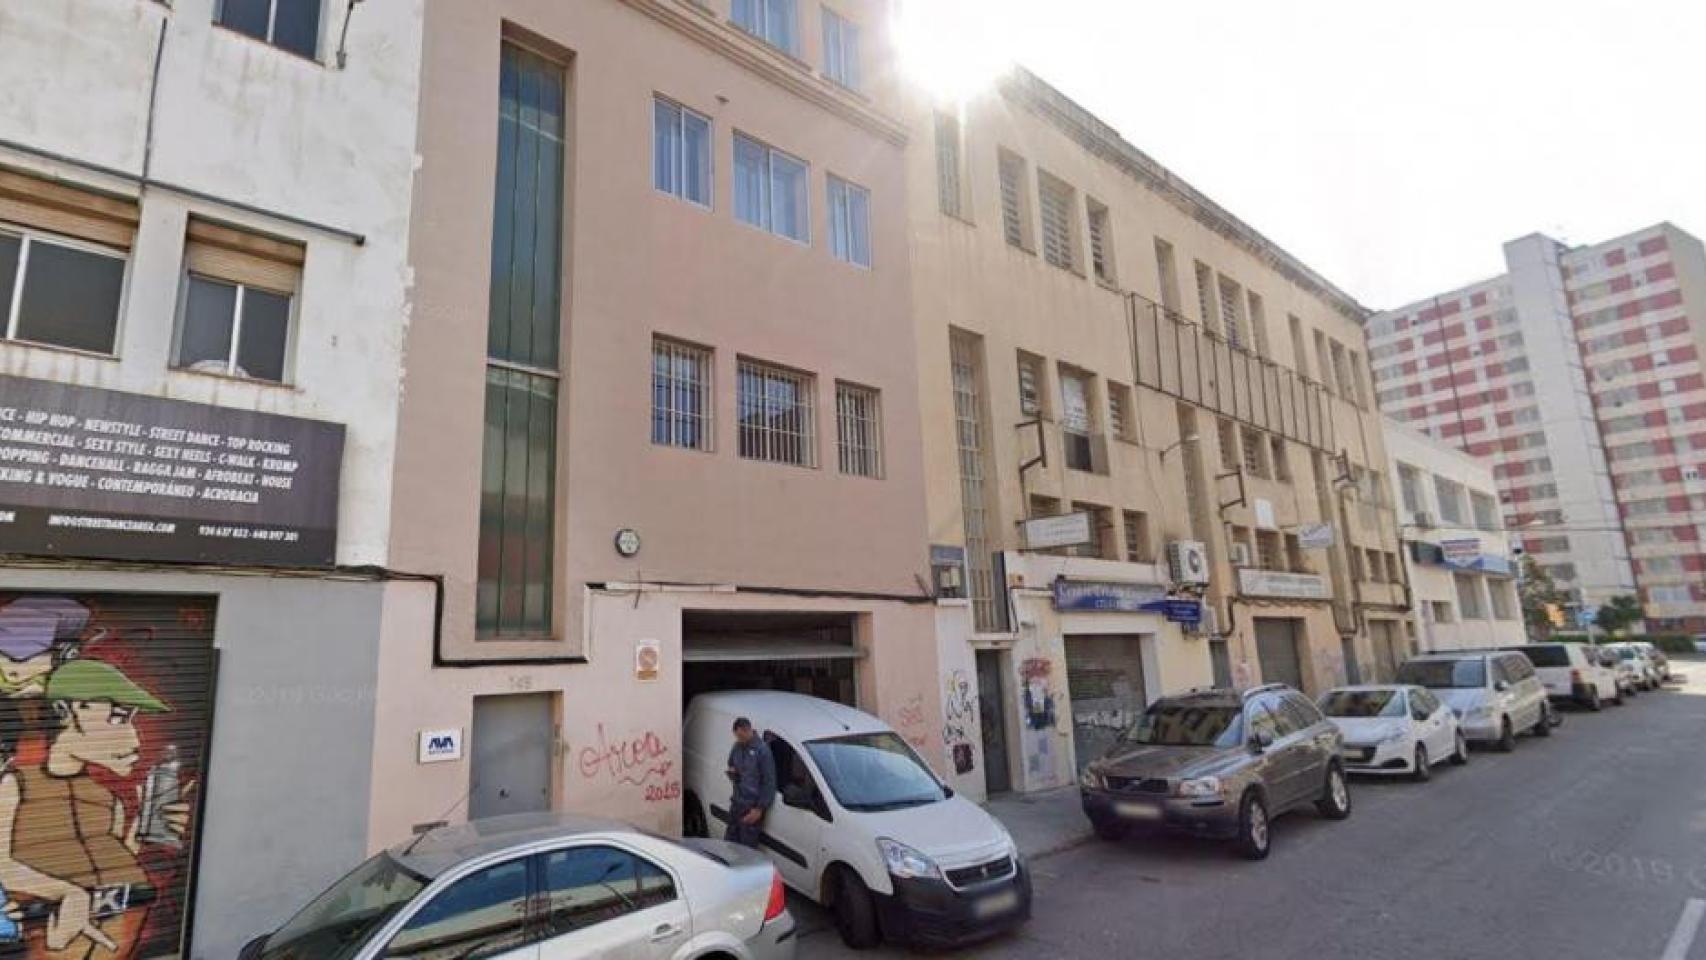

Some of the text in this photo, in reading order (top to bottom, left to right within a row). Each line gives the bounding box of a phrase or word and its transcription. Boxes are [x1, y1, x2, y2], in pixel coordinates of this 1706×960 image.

[0, 425, 75, 449] OMMERCIAL
[85, 438, 115, 451] SEXY
[115, 440, 146, 455] STYLE
[154, 445, 182, 460] SEXY
[183, 449, 211, 463] HEELS
[26, 411, 48, 424] HIP
[49, 414, 76, 428] HOP
[84, 418, 142, 437] NEWSTYLE
[149, 427, 187, 442] STREET
[186, 431, 220, 446] DANCE
[227, 436, 248, 449] TOP
[248, 439, 290, 455] ROCKING
[0, 448, 50, 464] OPPING
[60, 451, 124, 471] DANCEHALL
[171, 465, 196, 478] JAM
[204, 469, 254, 484] AFROBEAT
[262, 475, 293, 489] HOUSE
[49, 472, 89, 488] VOGUE
[202, 487, 258, 502] ACROBACIA
